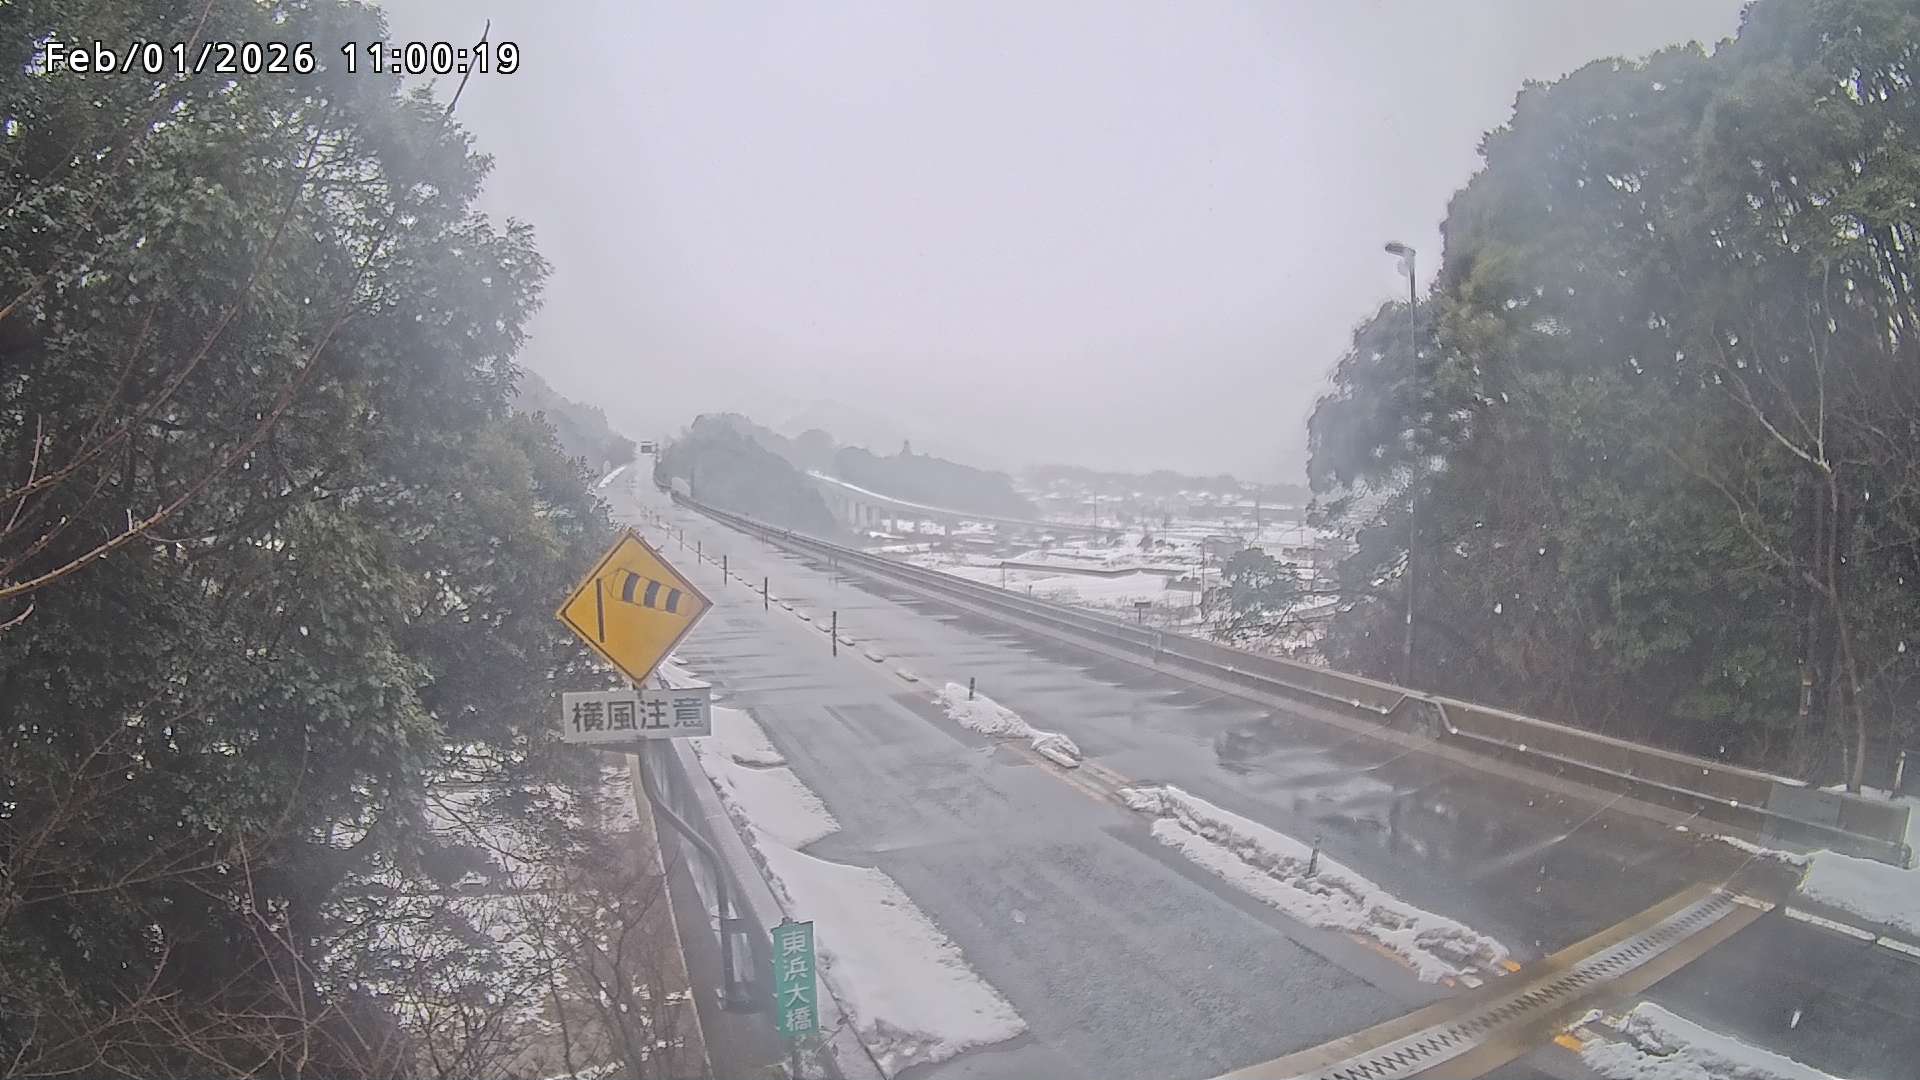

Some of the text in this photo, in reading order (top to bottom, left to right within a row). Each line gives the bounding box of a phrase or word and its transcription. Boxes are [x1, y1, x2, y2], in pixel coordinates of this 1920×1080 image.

[572, 697, 705, 733] 横風注意
[782, 929, 813, 1032] 東浜大橋
